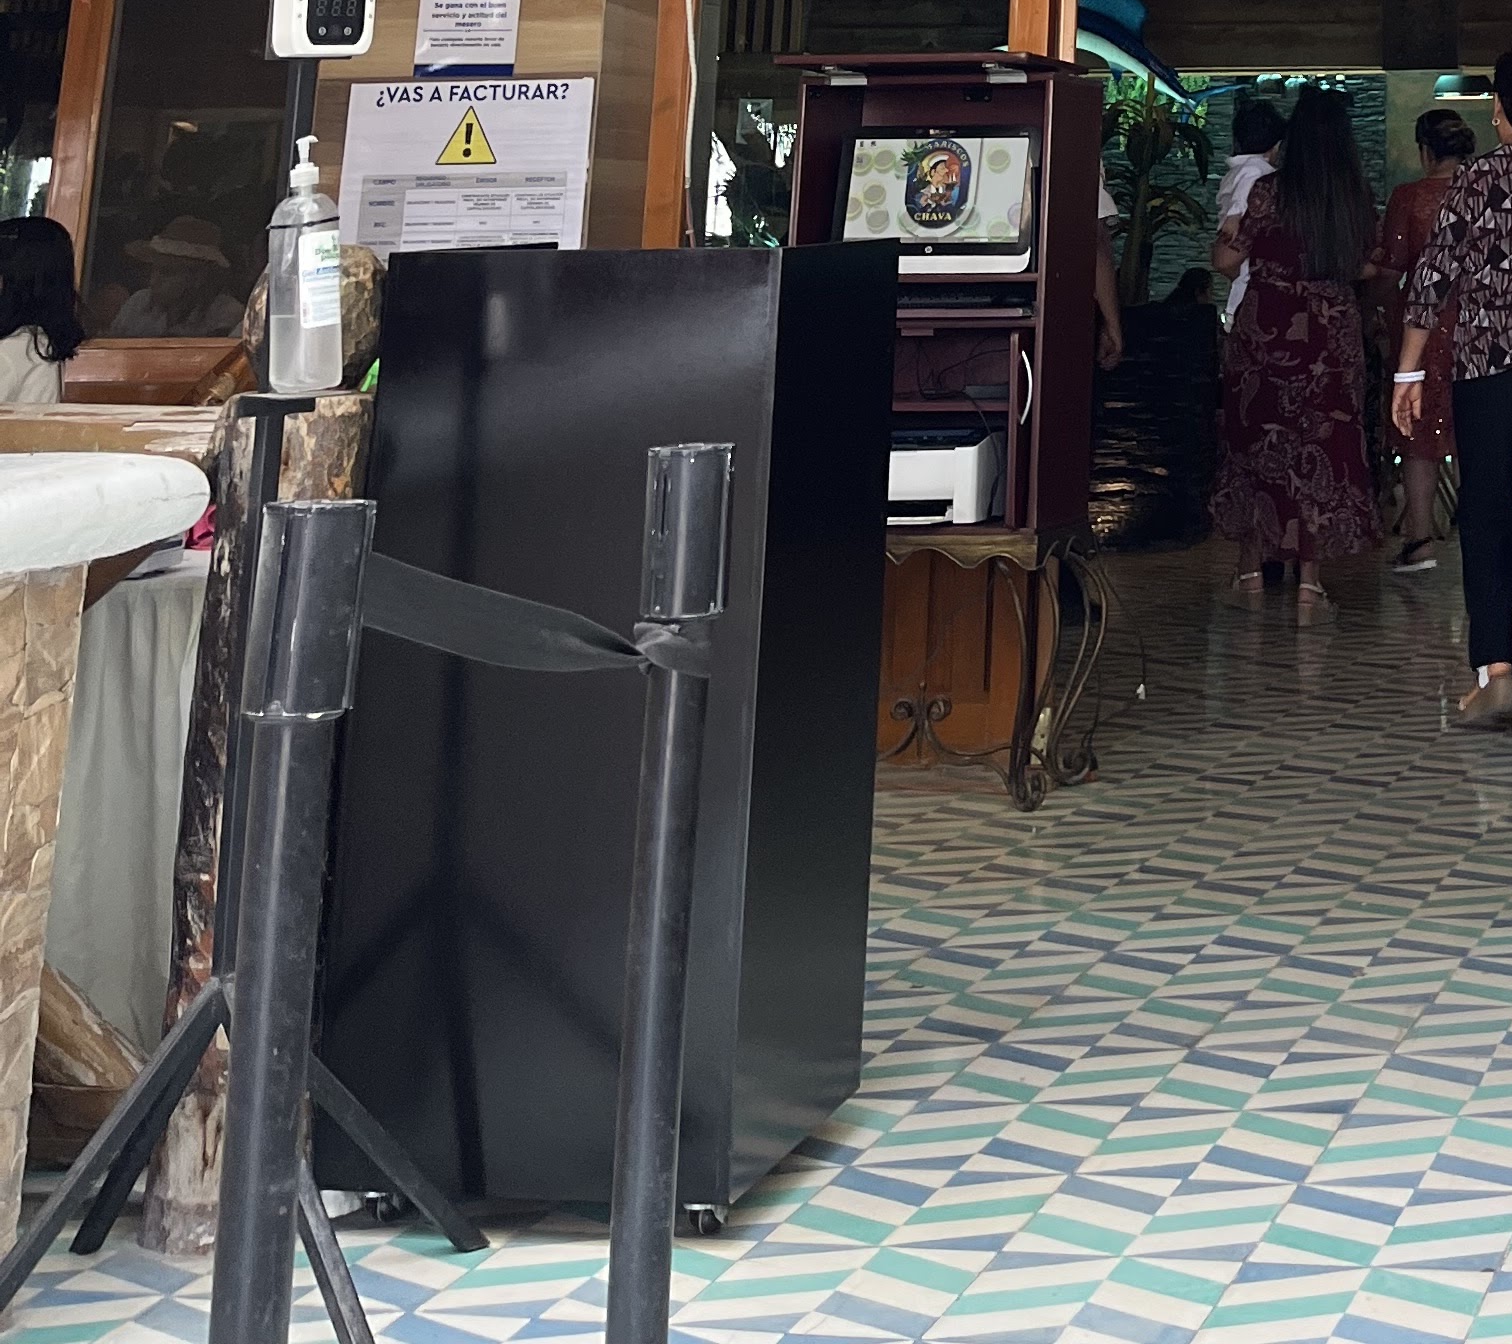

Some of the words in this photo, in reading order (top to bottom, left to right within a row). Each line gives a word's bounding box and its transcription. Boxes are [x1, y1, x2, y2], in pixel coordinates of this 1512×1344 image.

[376, 85, 424, 108] ¿VAS
[428, 85, 443, 103] A
[449, 82, 570, 102] FACTURAR?
[913, 212, 952, 221] CHAVA
